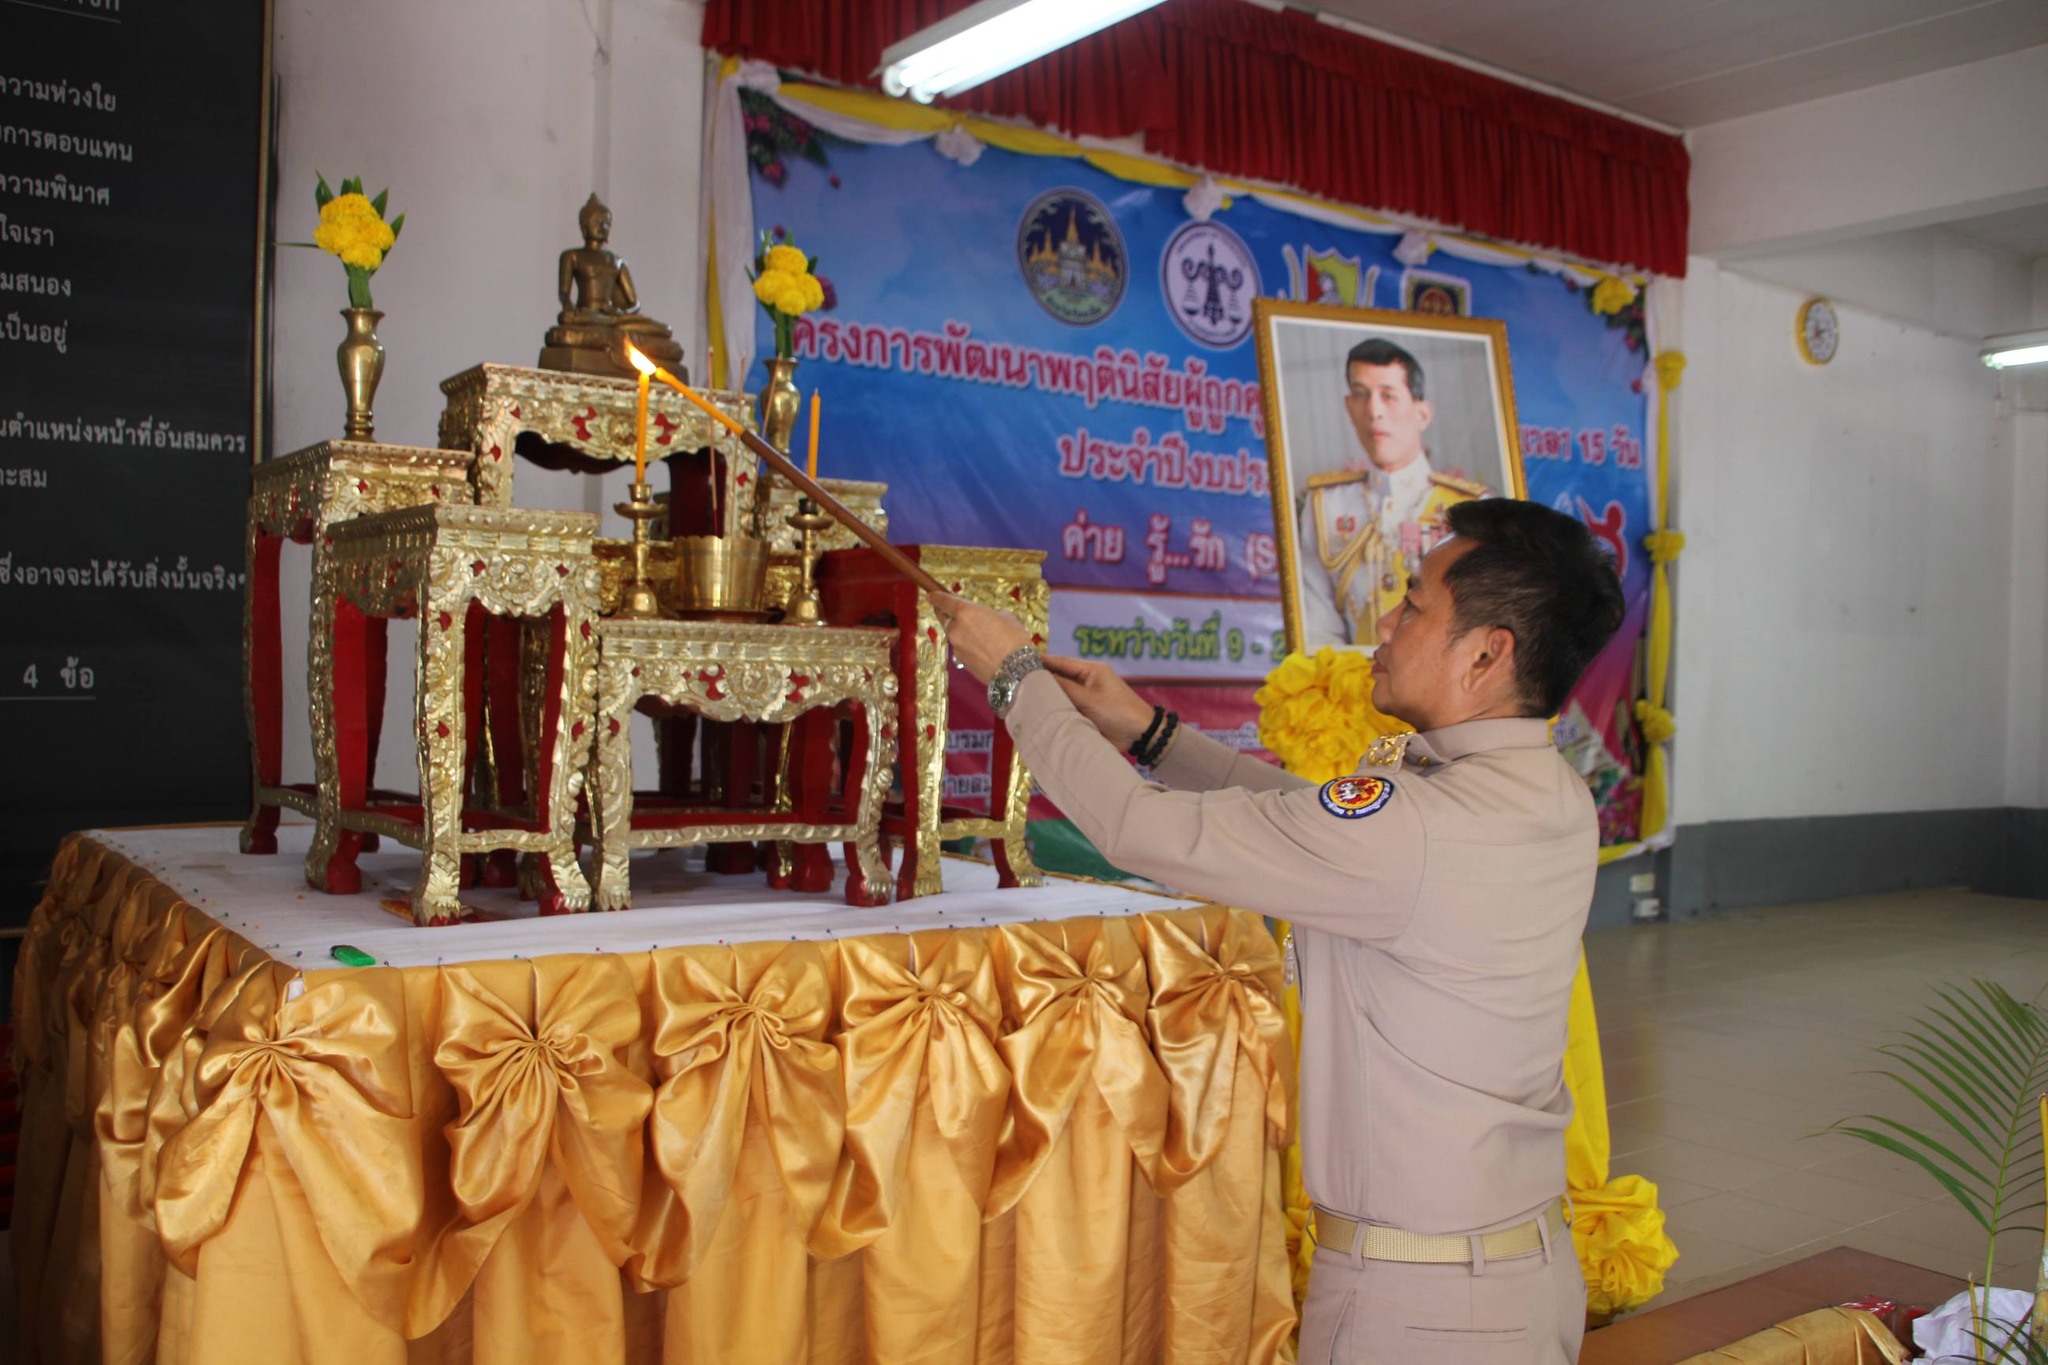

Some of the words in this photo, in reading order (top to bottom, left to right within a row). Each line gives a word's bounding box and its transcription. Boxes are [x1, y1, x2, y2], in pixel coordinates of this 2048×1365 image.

[0, 124, 133, 162] การตอบแทน
[1578, 429, 1606, 465] 15
[1611, 424, 1641, 468] วัน
[1063, 508, 1124, 563] ค่าย
[1073, 609, 1221, 662] ระหว่างวันที่
[1226, 627, 1244, 662] 9
[23, 664, 39, 688] 4
[60, 655, 95, 689] ข้อ
